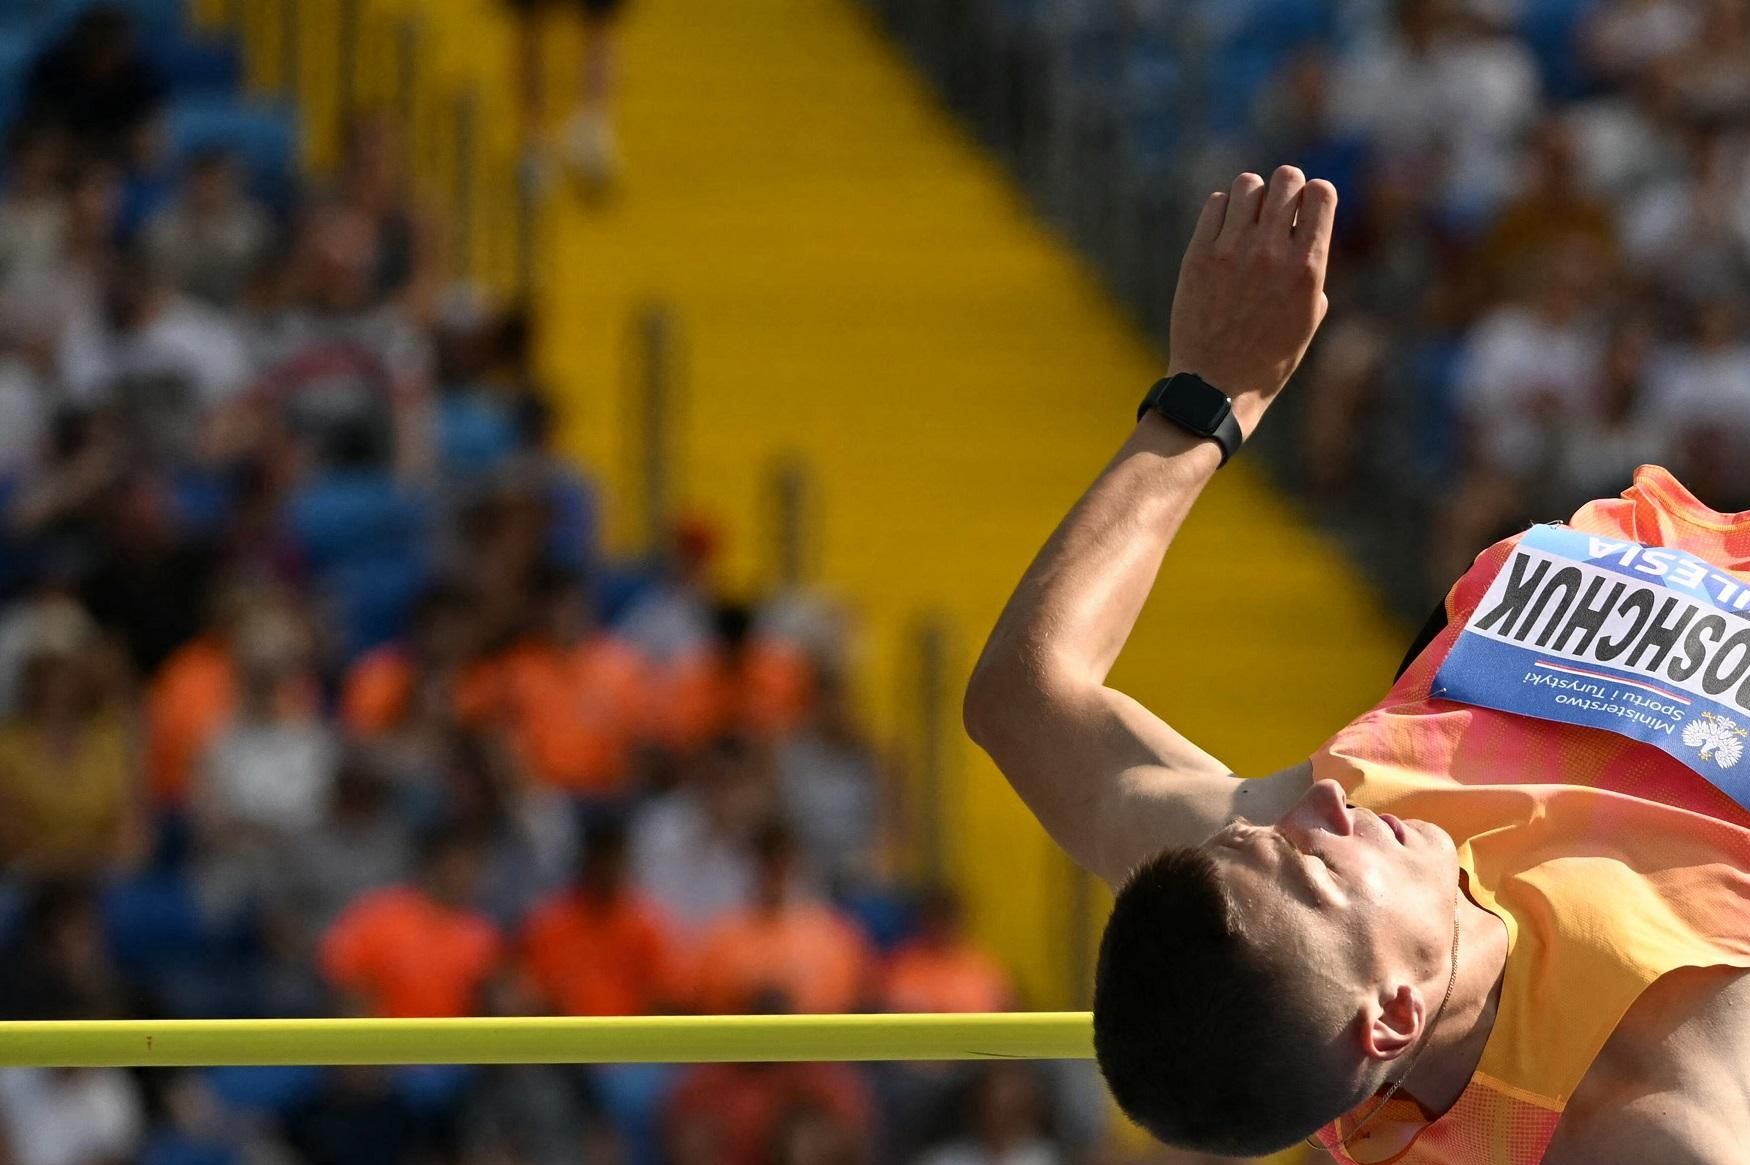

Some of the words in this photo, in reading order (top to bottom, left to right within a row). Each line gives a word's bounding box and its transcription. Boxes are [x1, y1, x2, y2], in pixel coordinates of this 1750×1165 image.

[1522, 672, 1605, 698] Turystyki
[1610, 690, 1620, 701] i
[1555, 694, 1676, 735] Ministerstwo
[1622, 691, 1685, 721] Sportu
